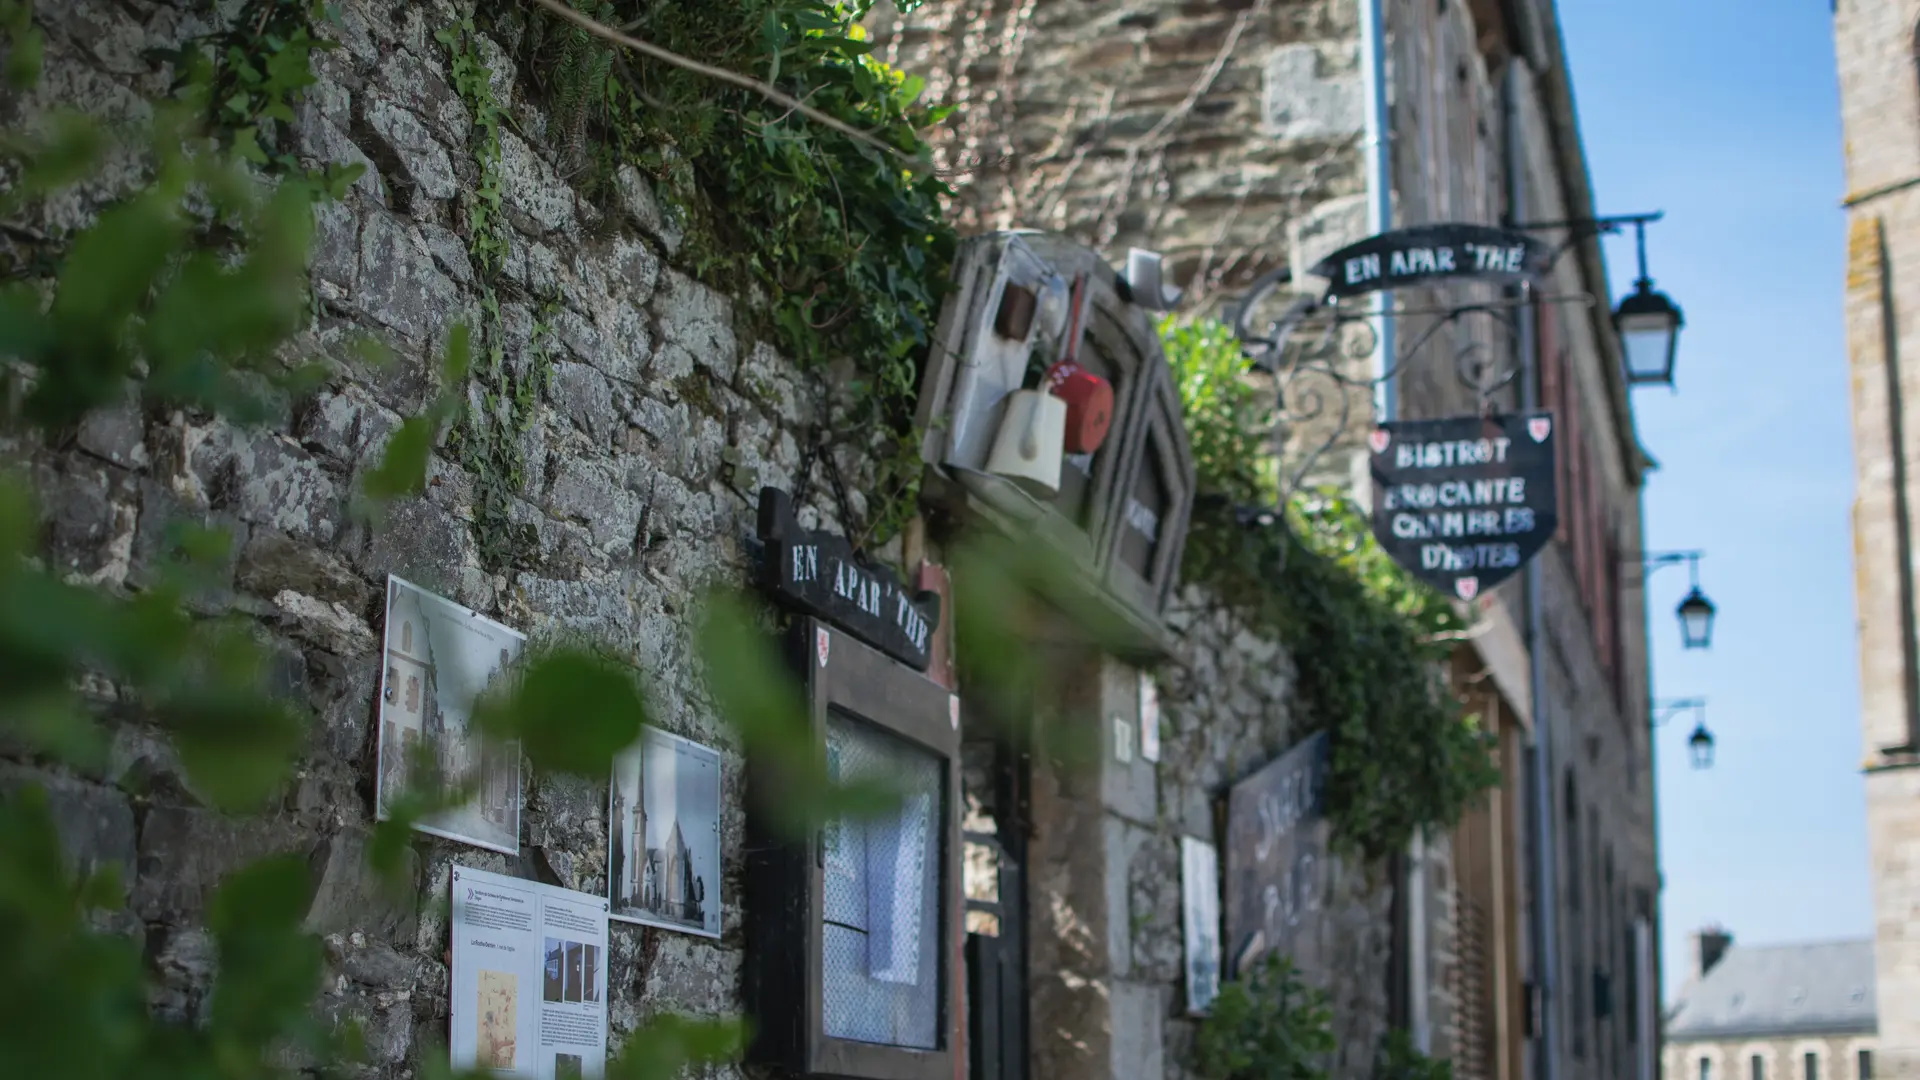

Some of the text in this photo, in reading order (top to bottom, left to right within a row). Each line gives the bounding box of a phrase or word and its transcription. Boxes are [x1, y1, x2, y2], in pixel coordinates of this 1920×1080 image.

[1345, 253, 1380, 285] EN
[1391, 246, 1456, 277] APAR
[1395, 437, 1511, 469] BISTROT
[792, 544, 818, 582] EN
